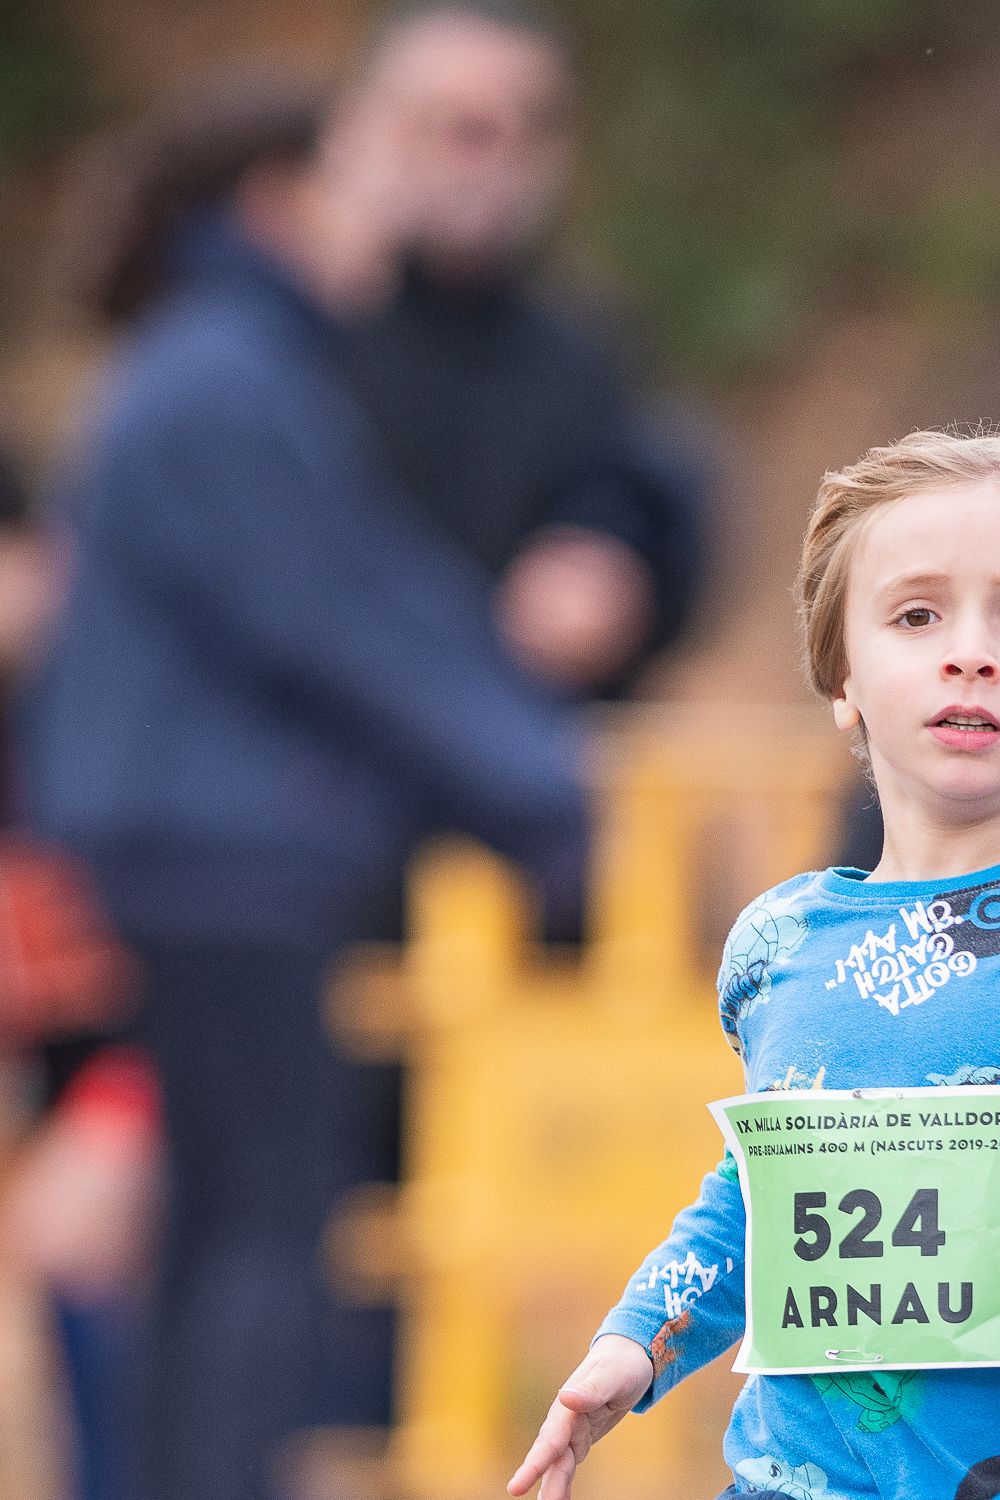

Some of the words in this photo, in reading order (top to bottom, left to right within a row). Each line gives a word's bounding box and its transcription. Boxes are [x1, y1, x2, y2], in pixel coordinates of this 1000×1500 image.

[853, 932, 955, 1000] CATCH
[872, 951, 977, 1016] GOTTA
[736, 1119, 753, 1134] IX
[754, 1117, 782, 1132] MILLA
[785, 1111, 879, 1131] SOLIDÀRIA
[886, 1113, 911, 1127] DE
[748, 1143, 814, 1157] PRE-BENJAMINS
[819, 1142, 848, 1154] 400
[853, 1142, 865, 1152] M
[871, 1140, 943, 1156] (NASCUTS
[793, 1188, 946, 1262] 524
[781, 1282, 973, 1329] ARNAU
